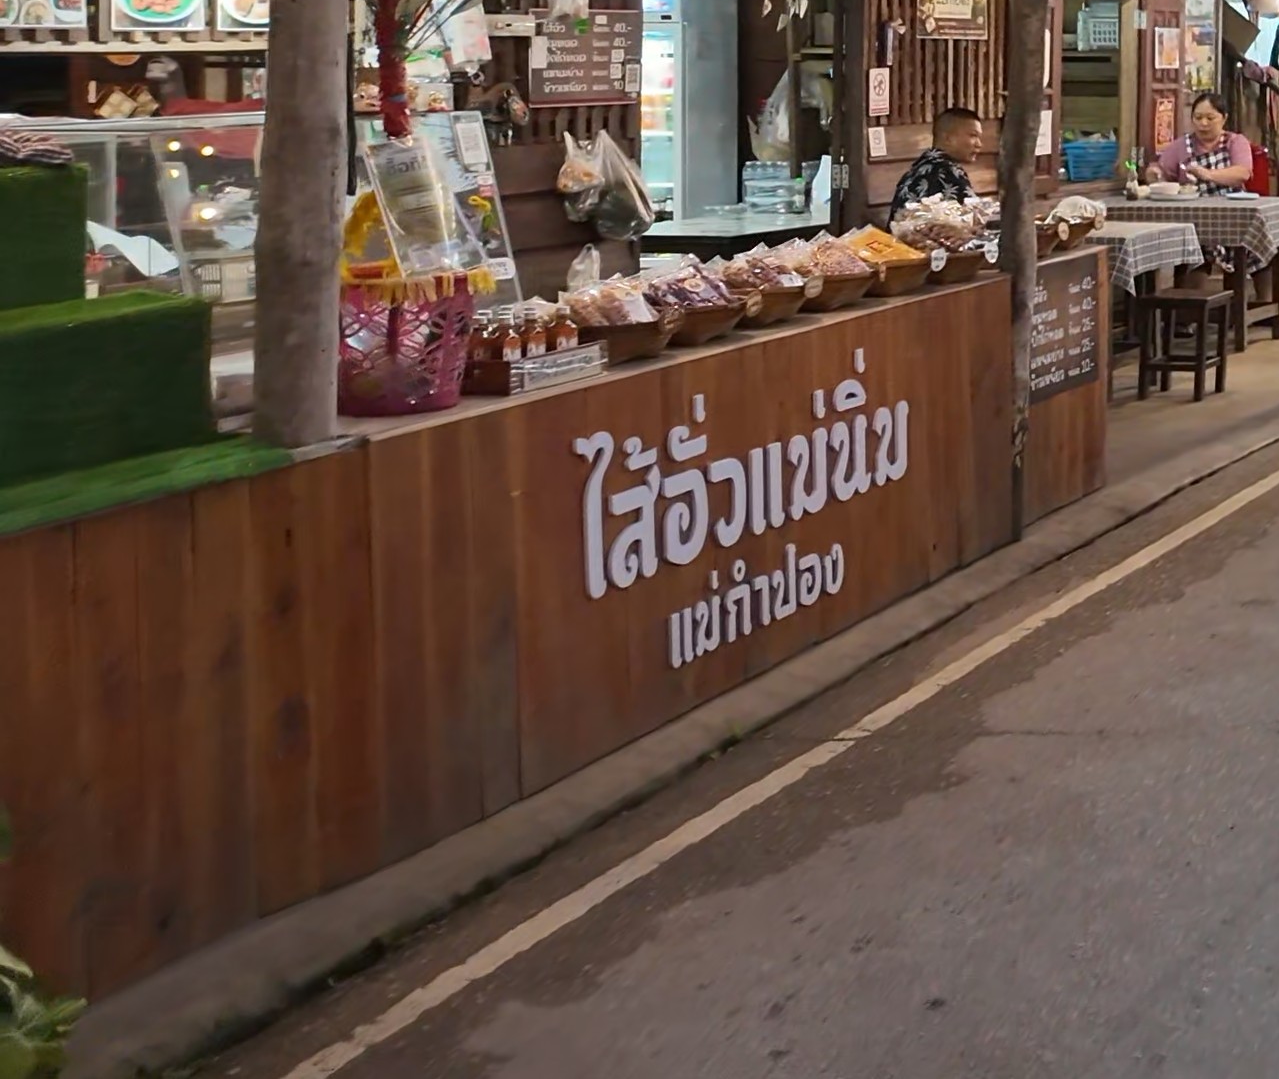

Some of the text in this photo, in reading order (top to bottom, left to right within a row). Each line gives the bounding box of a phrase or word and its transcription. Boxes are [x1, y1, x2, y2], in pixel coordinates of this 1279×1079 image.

[572, 346, 909, 600] ไส้อั่วแม่นิ่ม
[668, 543, 845, 670] แม่กำปอง
